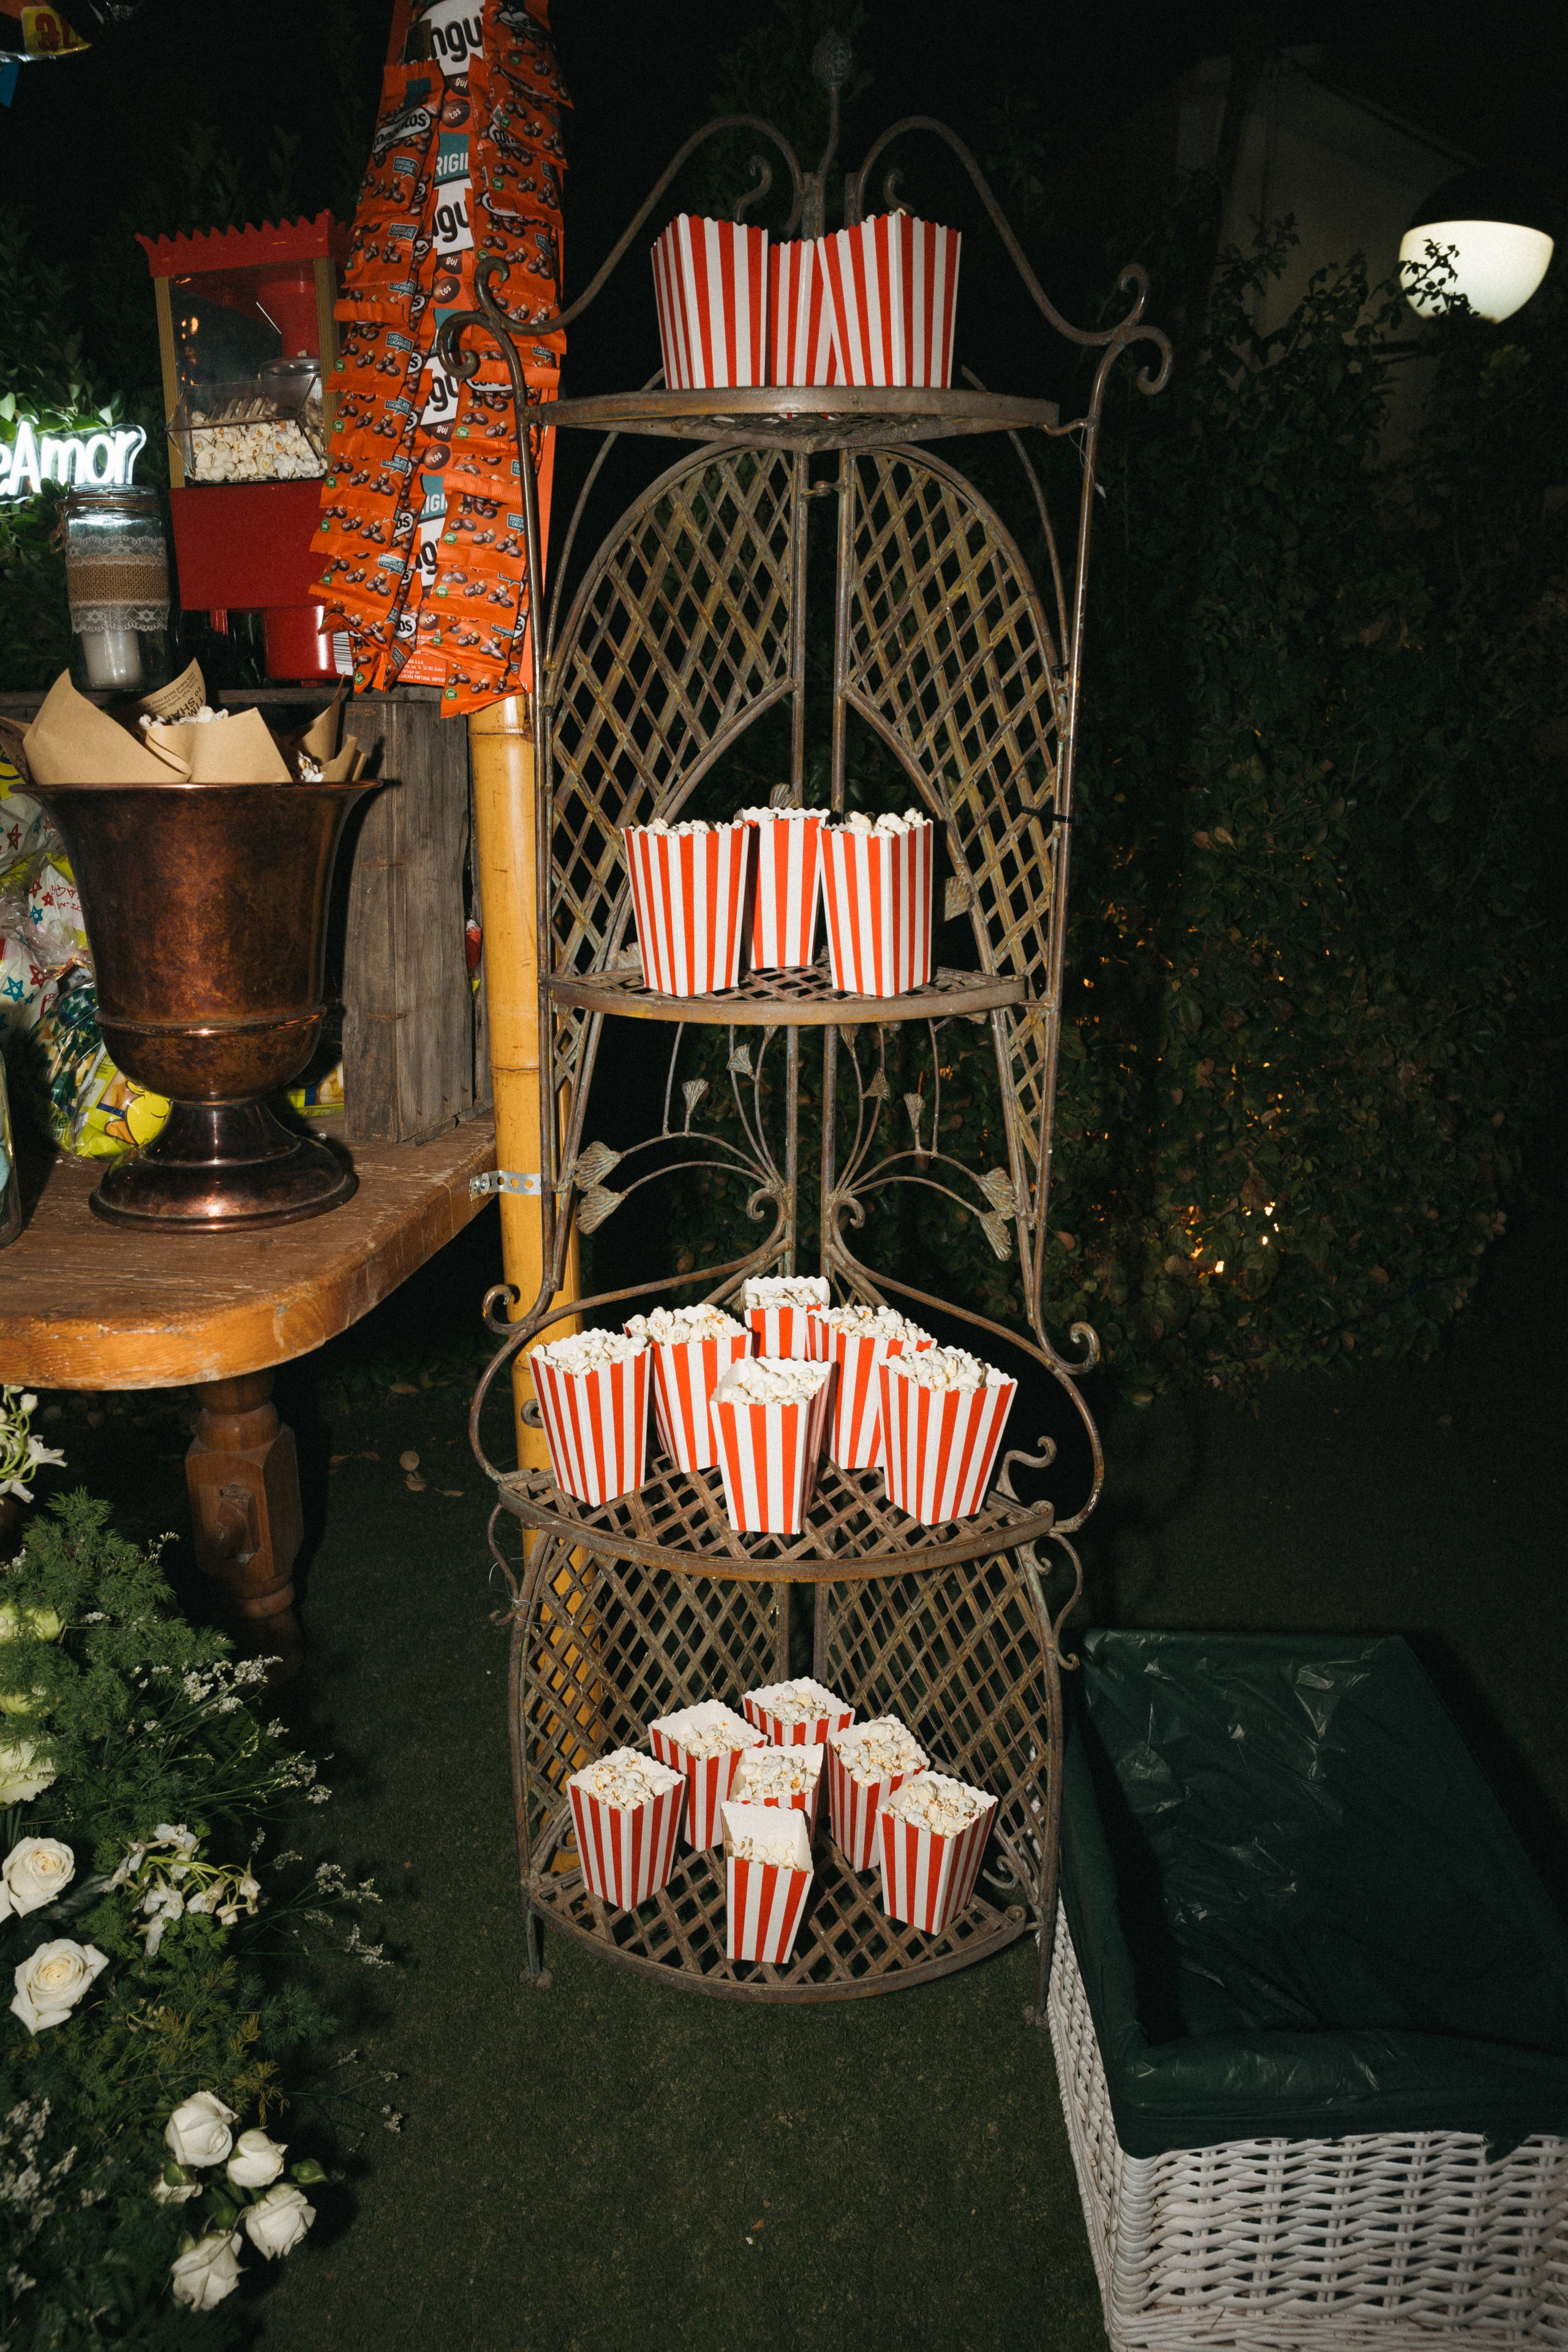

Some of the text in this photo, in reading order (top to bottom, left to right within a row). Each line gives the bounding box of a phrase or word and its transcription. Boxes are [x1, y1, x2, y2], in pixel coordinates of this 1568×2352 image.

[455, 78, 468, 89] gui
[448, 107, 461, 119] tos
[446, 257, 458, 266] gui
[439, 285, 451, 296] tos
[388, 333, 412, 347] CHOCOLATE
[437, 426, 448, 435] gui
[431, 452, 442, 463] tos
[381, 557, 404, 568] CHOCOLATE
[426, 613, 436, 624] tos
[163, 690, 176, 700] bread
[194, 687, 202, 696] to
